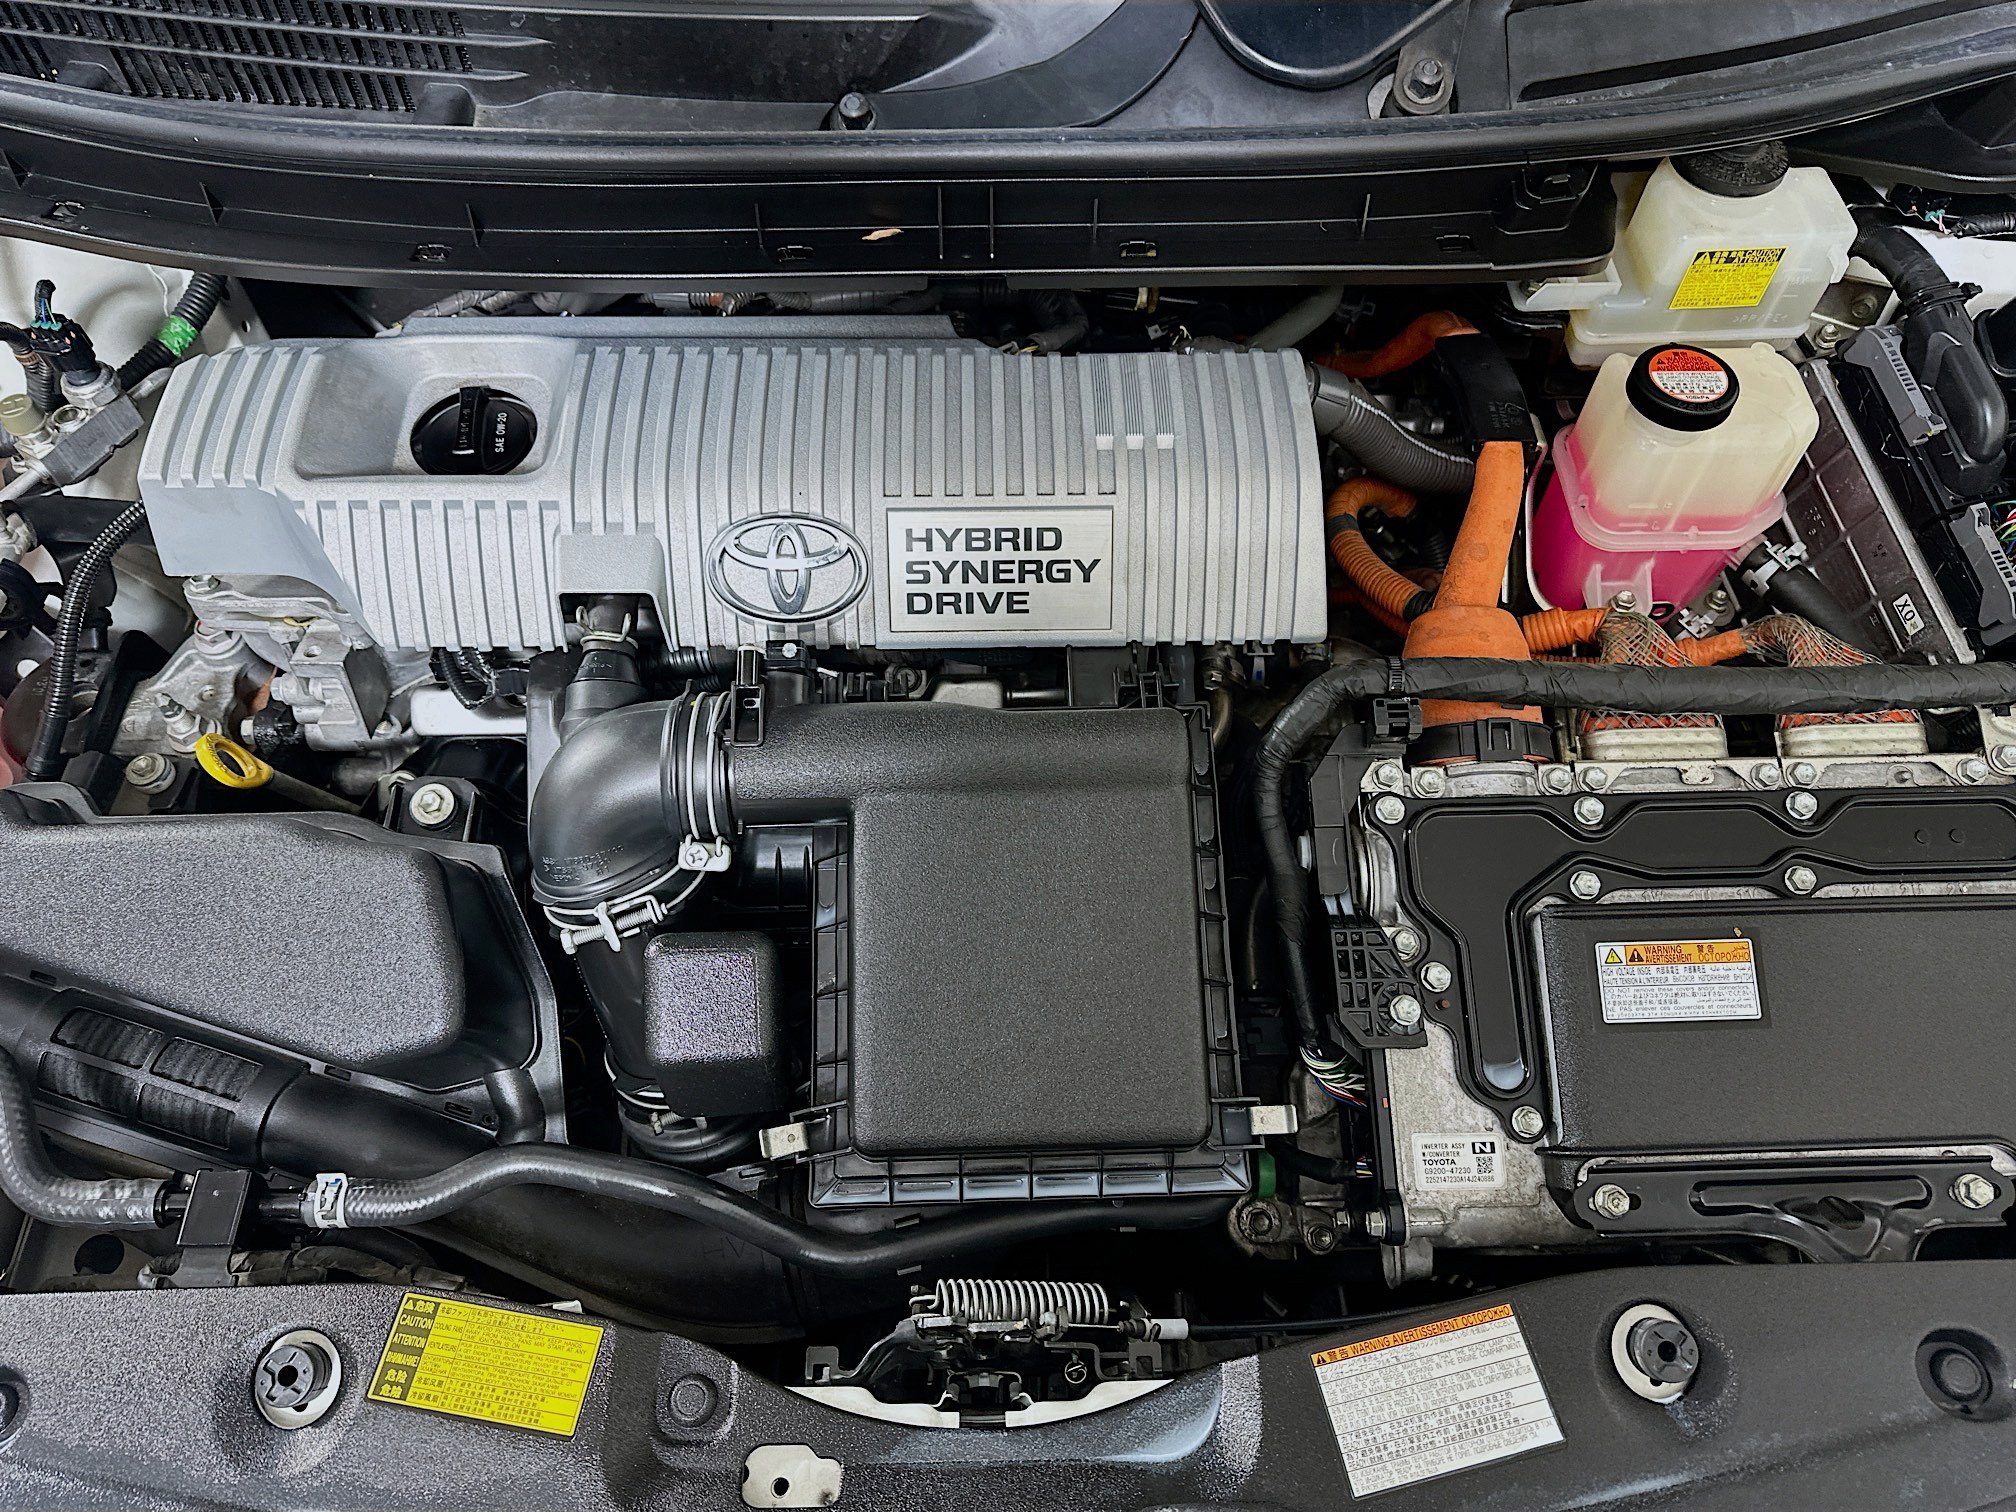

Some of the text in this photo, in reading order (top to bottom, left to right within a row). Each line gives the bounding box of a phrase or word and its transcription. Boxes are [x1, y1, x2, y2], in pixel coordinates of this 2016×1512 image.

[1731, 255, 1779, 263] ATTENTION
[495, 412, 508, 452] SAE 0W-20
[905, 528, 1062, 552] HYBRID
[906, 559, 1102, 584] SYNERGY
[906, 592, 1030, 614] DRIVE
[1643, 945, 1682, 954] WARNING
[1645, 953, 1692, 963] AVERTISSEMENT
[1698, 951, 1750, 961] ОСТОРОЖНО
[1474, 1142, 1492, 1153] N
[398, 1313, 433, 1329] CAUTION
[1460, 1305, 1510, 1326] ОСТОРОЖНО
[392, 1332, 426, 1348] ATTENTION
[1350, 1318, 1459, 1355] WARNING AVERTISSEMENT
[1377, 1365, 1399, 1377] PLEASE
[1436, 1351, 1452, 1361] THAT
[1454, 1347, 1466, 1356] THE
[1466, 1342, 1486, 1353] READY
[1339, 1383, 1359, 1395] METER
[1368, 1378, 1380, 1387] OFF
[1382, 1371, 1405, 1383] BEFORE
[1406, 1363, 1434, 1376] WORKING
[1443, 1358, 1456, 1367] THE
[1456, 1352, 1477, 1363] ENGINE
